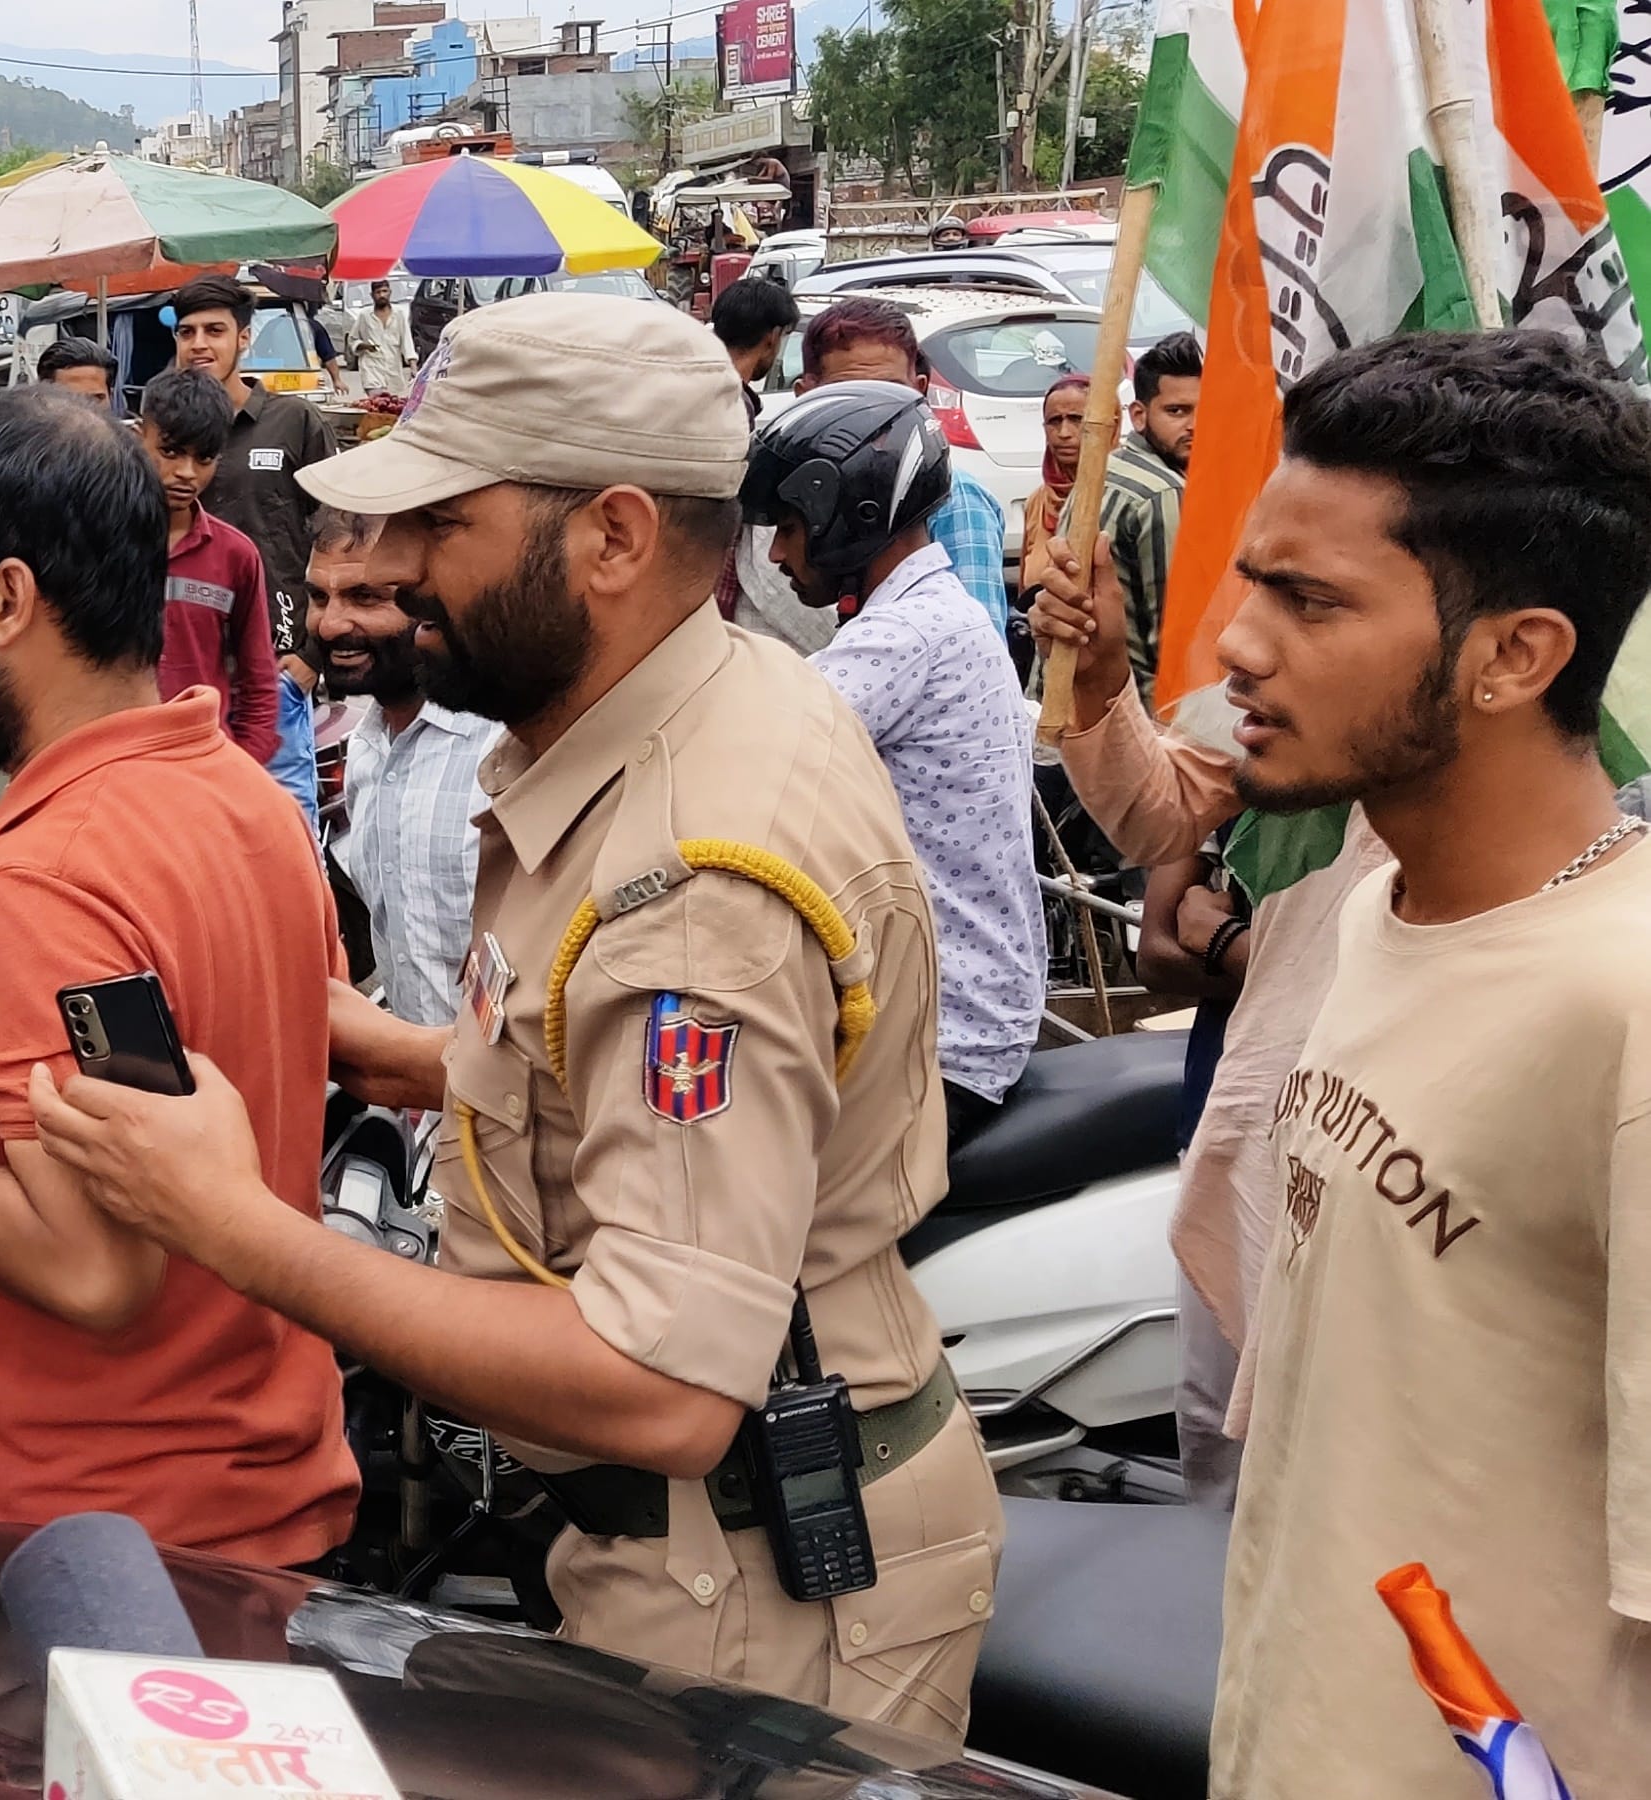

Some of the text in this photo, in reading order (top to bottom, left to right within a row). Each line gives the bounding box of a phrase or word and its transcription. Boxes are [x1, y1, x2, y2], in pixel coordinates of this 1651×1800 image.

[756, 3, 787, 24] SHREE
[756, 32, 787, 49] CEMENT
[1310, 1070, 1482, 1259] VUITTON
[136, 1680, 245, 1727] RS
